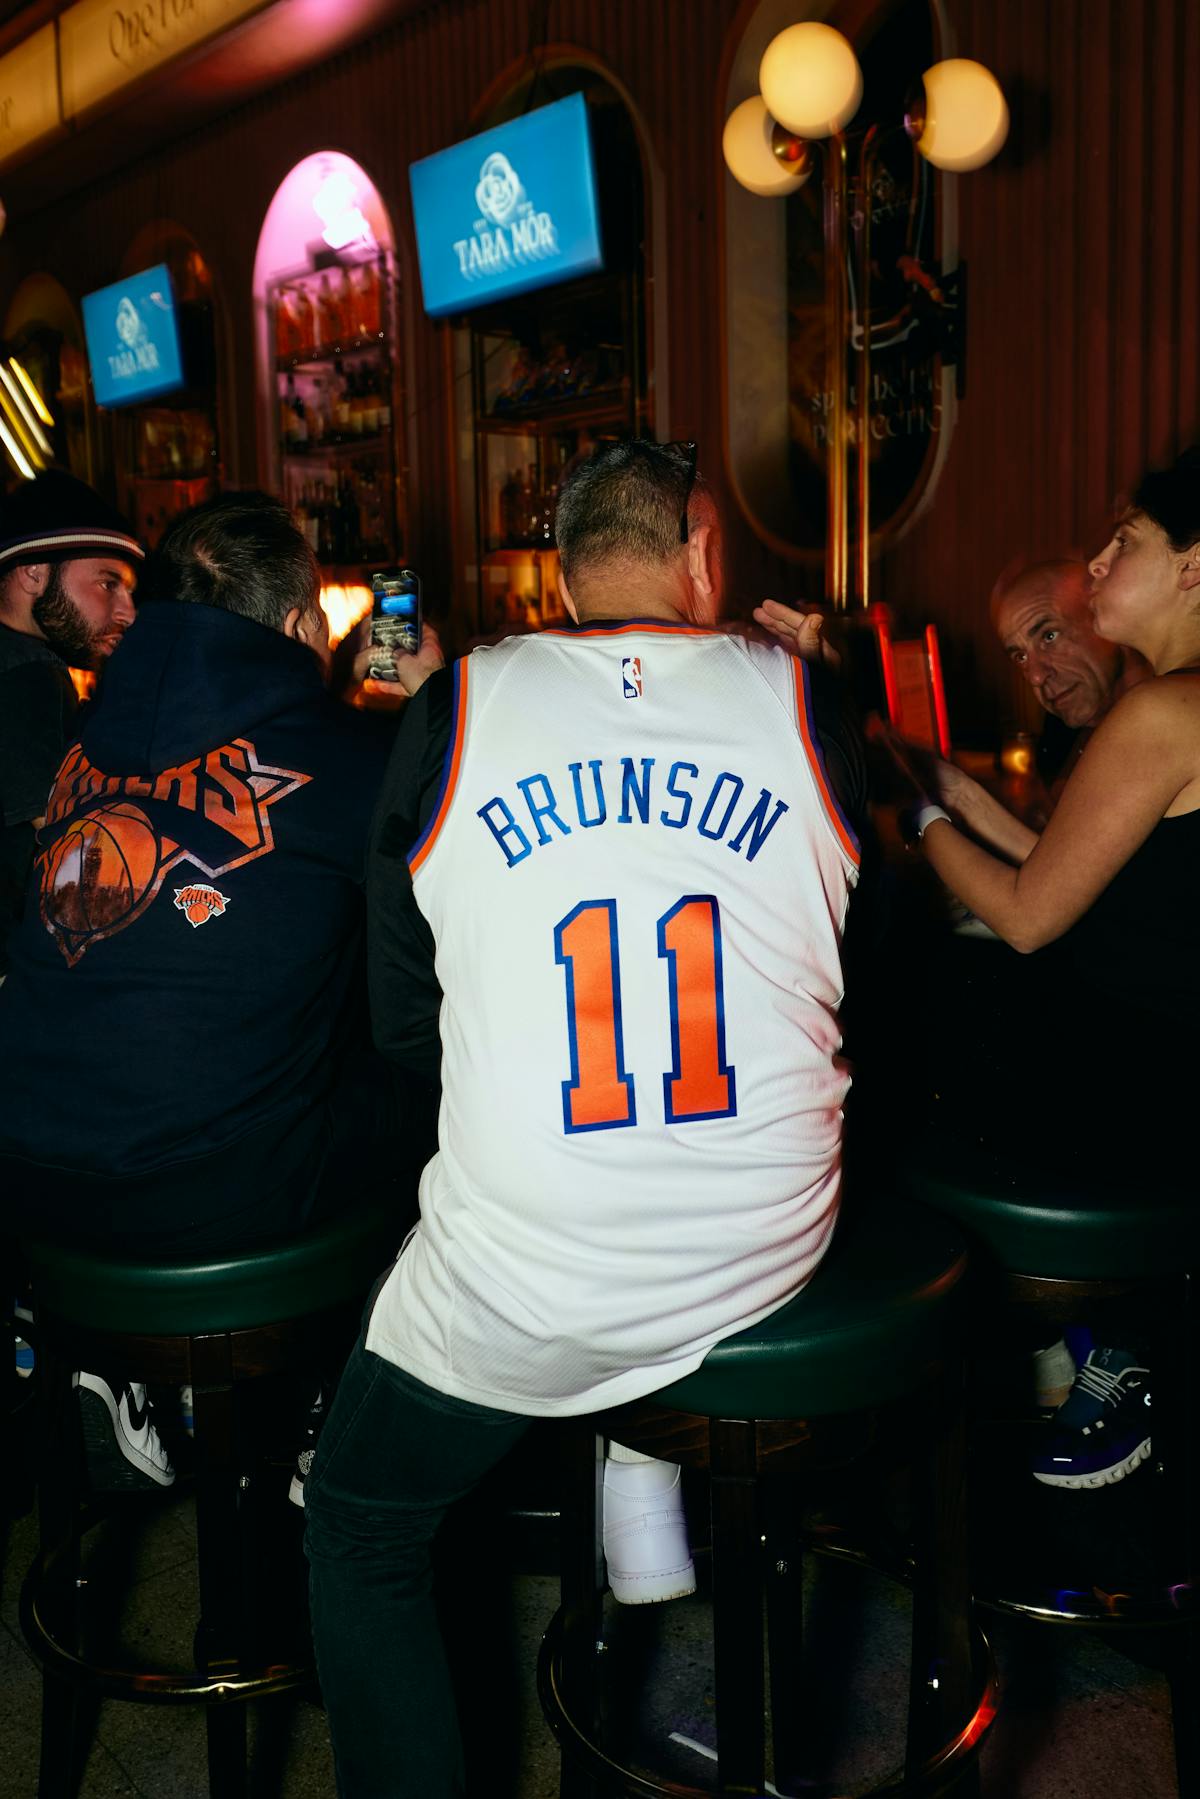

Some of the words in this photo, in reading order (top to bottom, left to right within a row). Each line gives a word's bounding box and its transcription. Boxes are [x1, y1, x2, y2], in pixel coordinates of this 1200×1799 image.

[453, 227, 512, 275] TARA
[477, 757, 789, 868] BRUNSON
[176, 887, 224, 911] KNICKS
[554, 895, 737, 1134] 11
